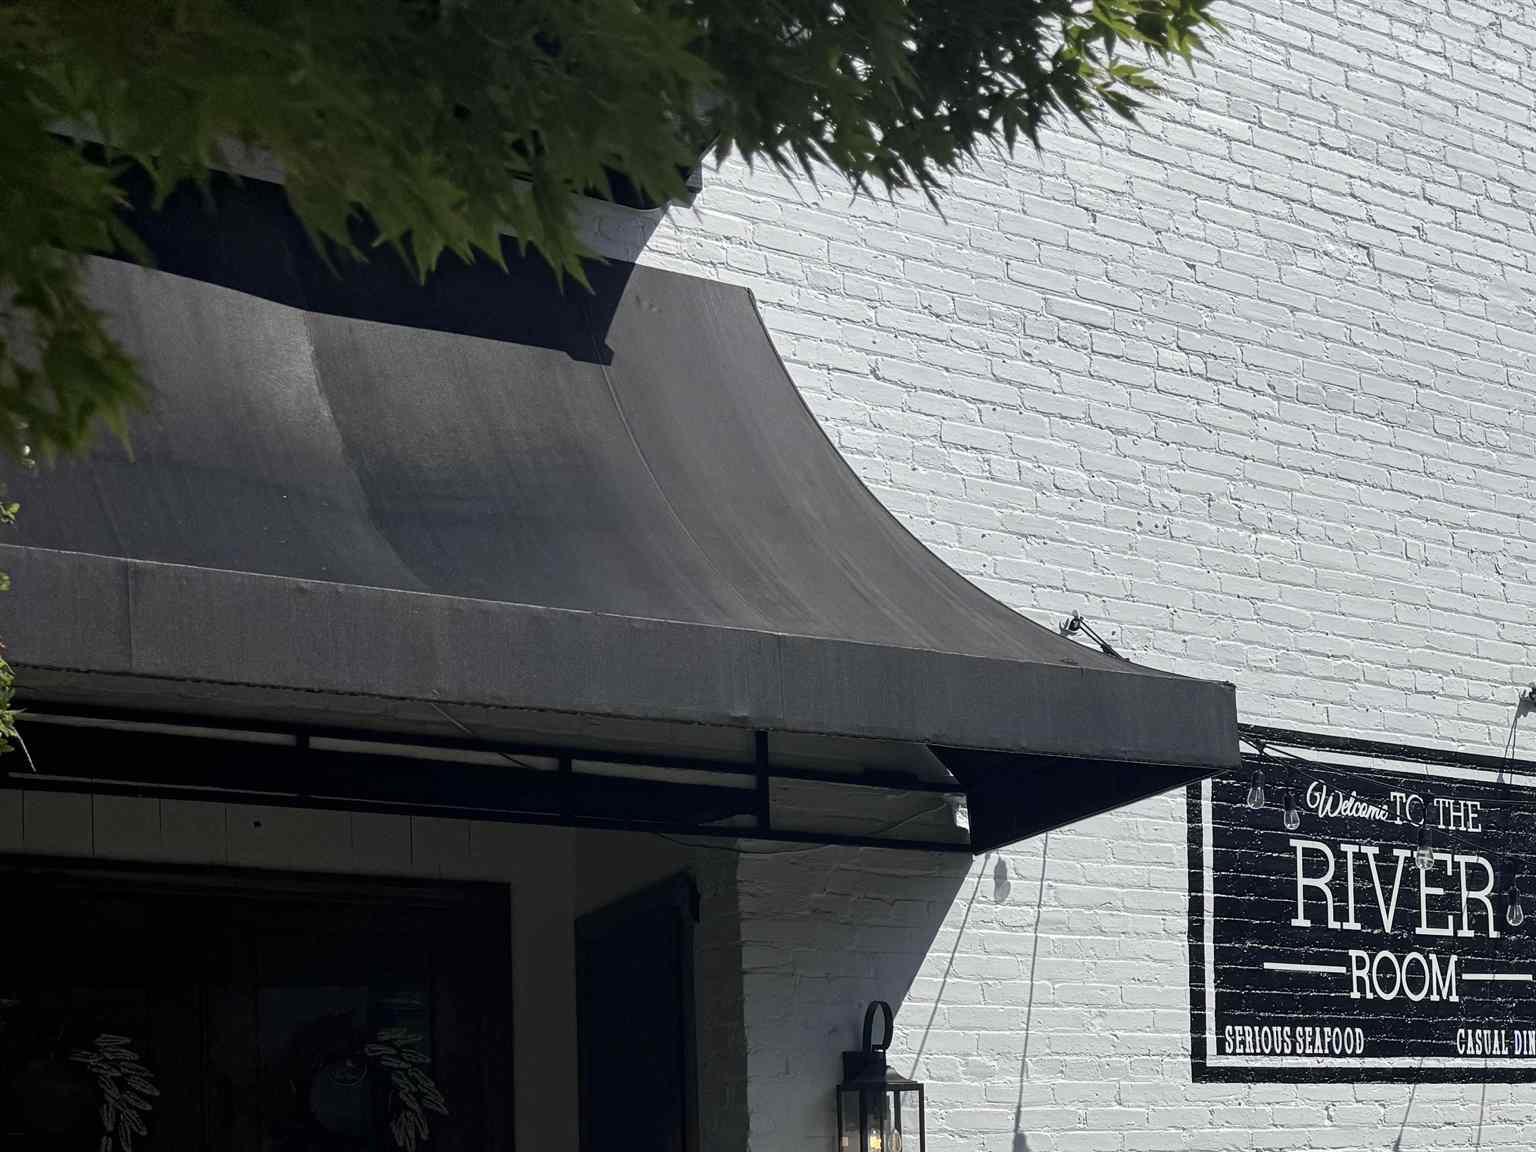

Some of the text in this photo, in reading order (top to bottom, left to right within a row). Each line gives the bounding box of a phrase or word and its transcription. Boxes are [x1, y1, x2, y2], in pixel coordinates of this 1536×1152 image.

[1306, 781, 1482, 833] Welcome TO THE
[1289, 838, 1500, 938] RIVER
[1349, 949, 1459, 1002] ROOM
[1224, 1025, 1365, 1055] SERIOUS SEAFOOD
[1456, 1028, 1509, 1055] CASUAL
